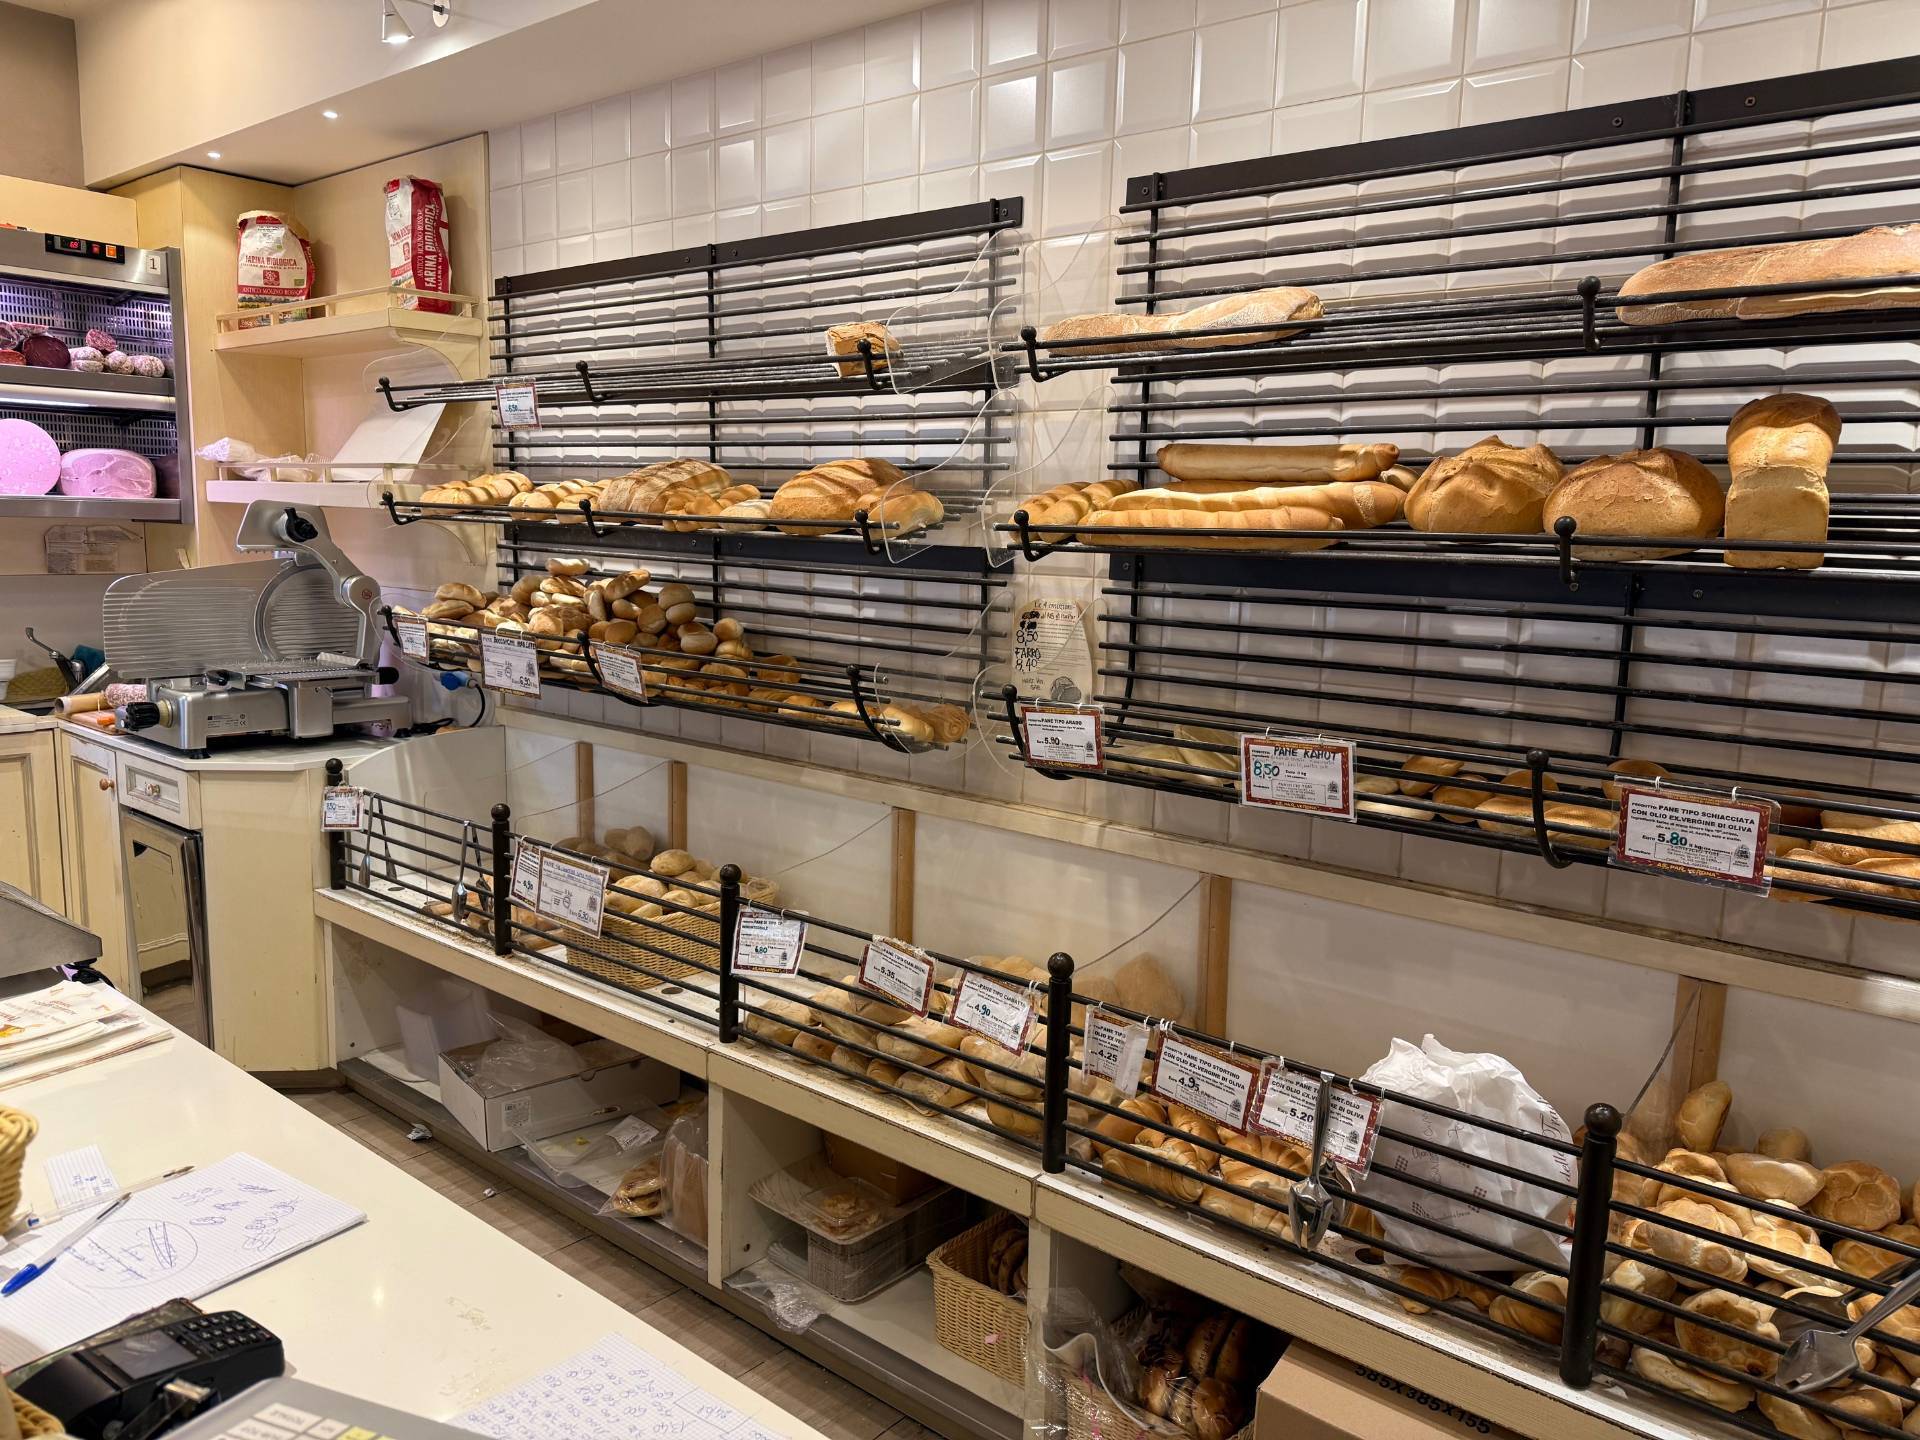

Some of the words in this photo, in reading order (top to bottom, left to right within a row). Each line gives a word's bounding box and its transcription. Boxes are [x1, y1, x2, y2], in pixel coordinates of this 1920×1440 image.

[425, 203, 437, 252] BIOLOGICA
[150, 258, 157, 270] 1
[245, 255, 266, 265] FARINA
[266, 256, 298, 267] BIOLOGICA
[424, 254, 438, 288] FARINA
[1016, 630, 1038, 646] 8,50
[1014, 648, 1041, 660] FARRO
[1274, 746, 1298, 756] PANE
[1631, 808, 1648, 817] CON
[1649, 812, 1667, 820] OLIO
[1668, 814, 1716, 828] EX.VERGINE
[1728, 823, 1753, 833] OLIVA
[1658, 805, 1680, 814] PANE
[1681, 808, 1700, 816] TIPO
[1701, 812, 1756, 825] SCHIACCIATA
[1658, 832, 1688, 846] 5.80
[880, 966, 896, 979] 5.35
[979, 984, 992, 993] PANE
[1098, 1050, 1118, 1062] 4.25
[1164, 1052, 1175, 1060] CON
[1176, 1055, 1188, 1064] OLIO
[1189, 1060, 1220, 1079] EX.VERGINE
[1222, 1074, 1228, 1082] DI
[1228, 1078, 1245, 1090] OLIVA
[1184, 1052, 1198, 1062] PANE
[1200, 1057, 1212, 1067] TIPO
[1212, 1064, 1240, 1080] STORTINO
[1178, 1076, 1200, 1092] 4.95
[1296, 1081, 1312, 1091] PANE
[1272, 1081, 1285, 1089] CON
[1286, 1086, 1300, 1095] OLIO
[1346, 1108, 1364, 1120] OLIVA
[1290, 1108, 1314, 1123] 5.20
